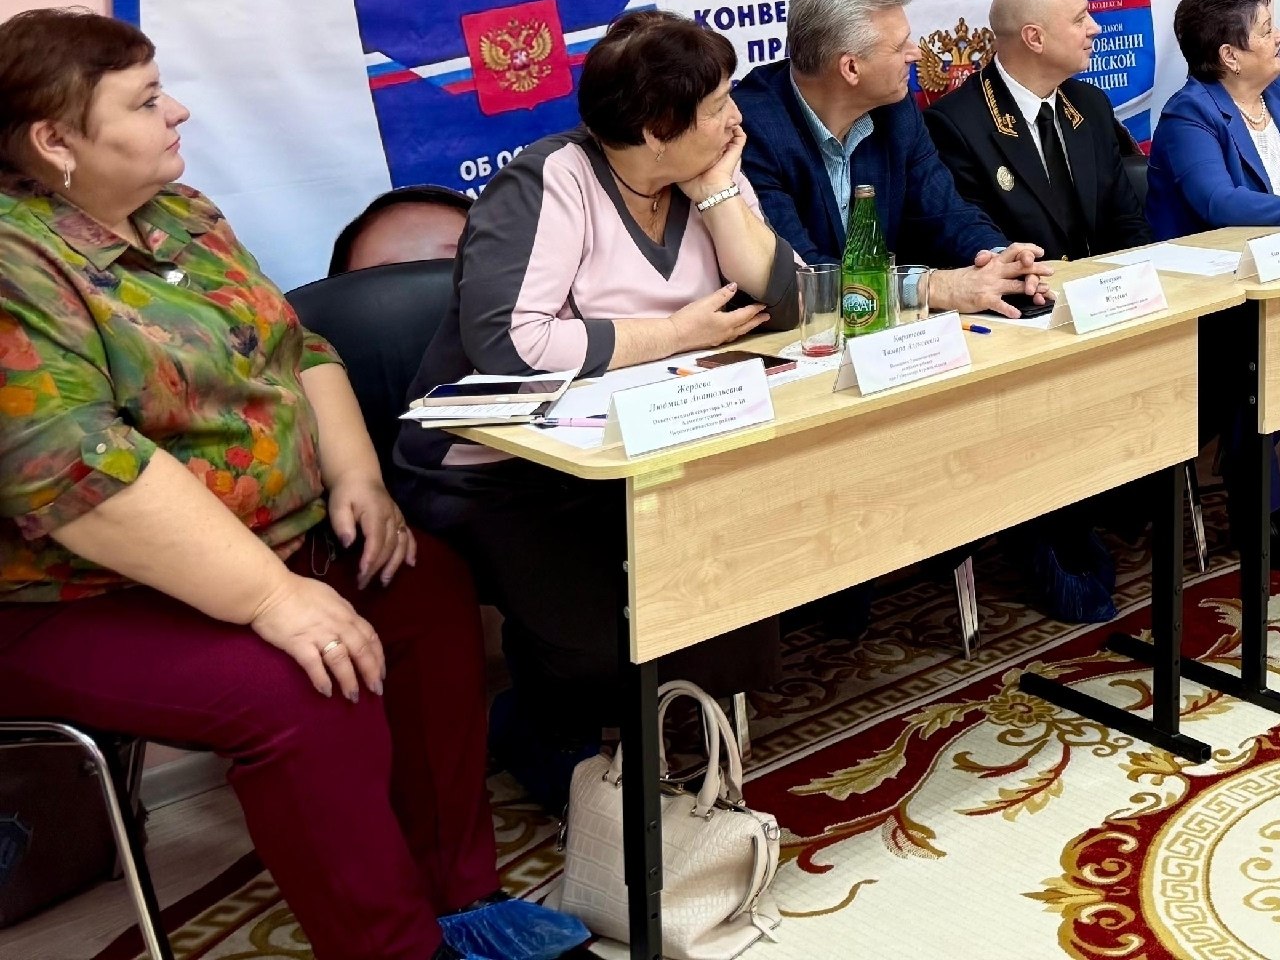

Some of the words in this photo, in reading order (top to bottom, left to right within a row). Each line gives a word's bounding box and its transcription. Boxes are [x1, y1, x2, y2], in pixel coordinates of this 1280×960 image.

[694, 0, 788, 31] КОНВЕ
[1092, 33, 1144, 54] ОВАНИИ
[460, 155, 492, 181] ОБ
[843, 299, 877, 312] АРЗАН
